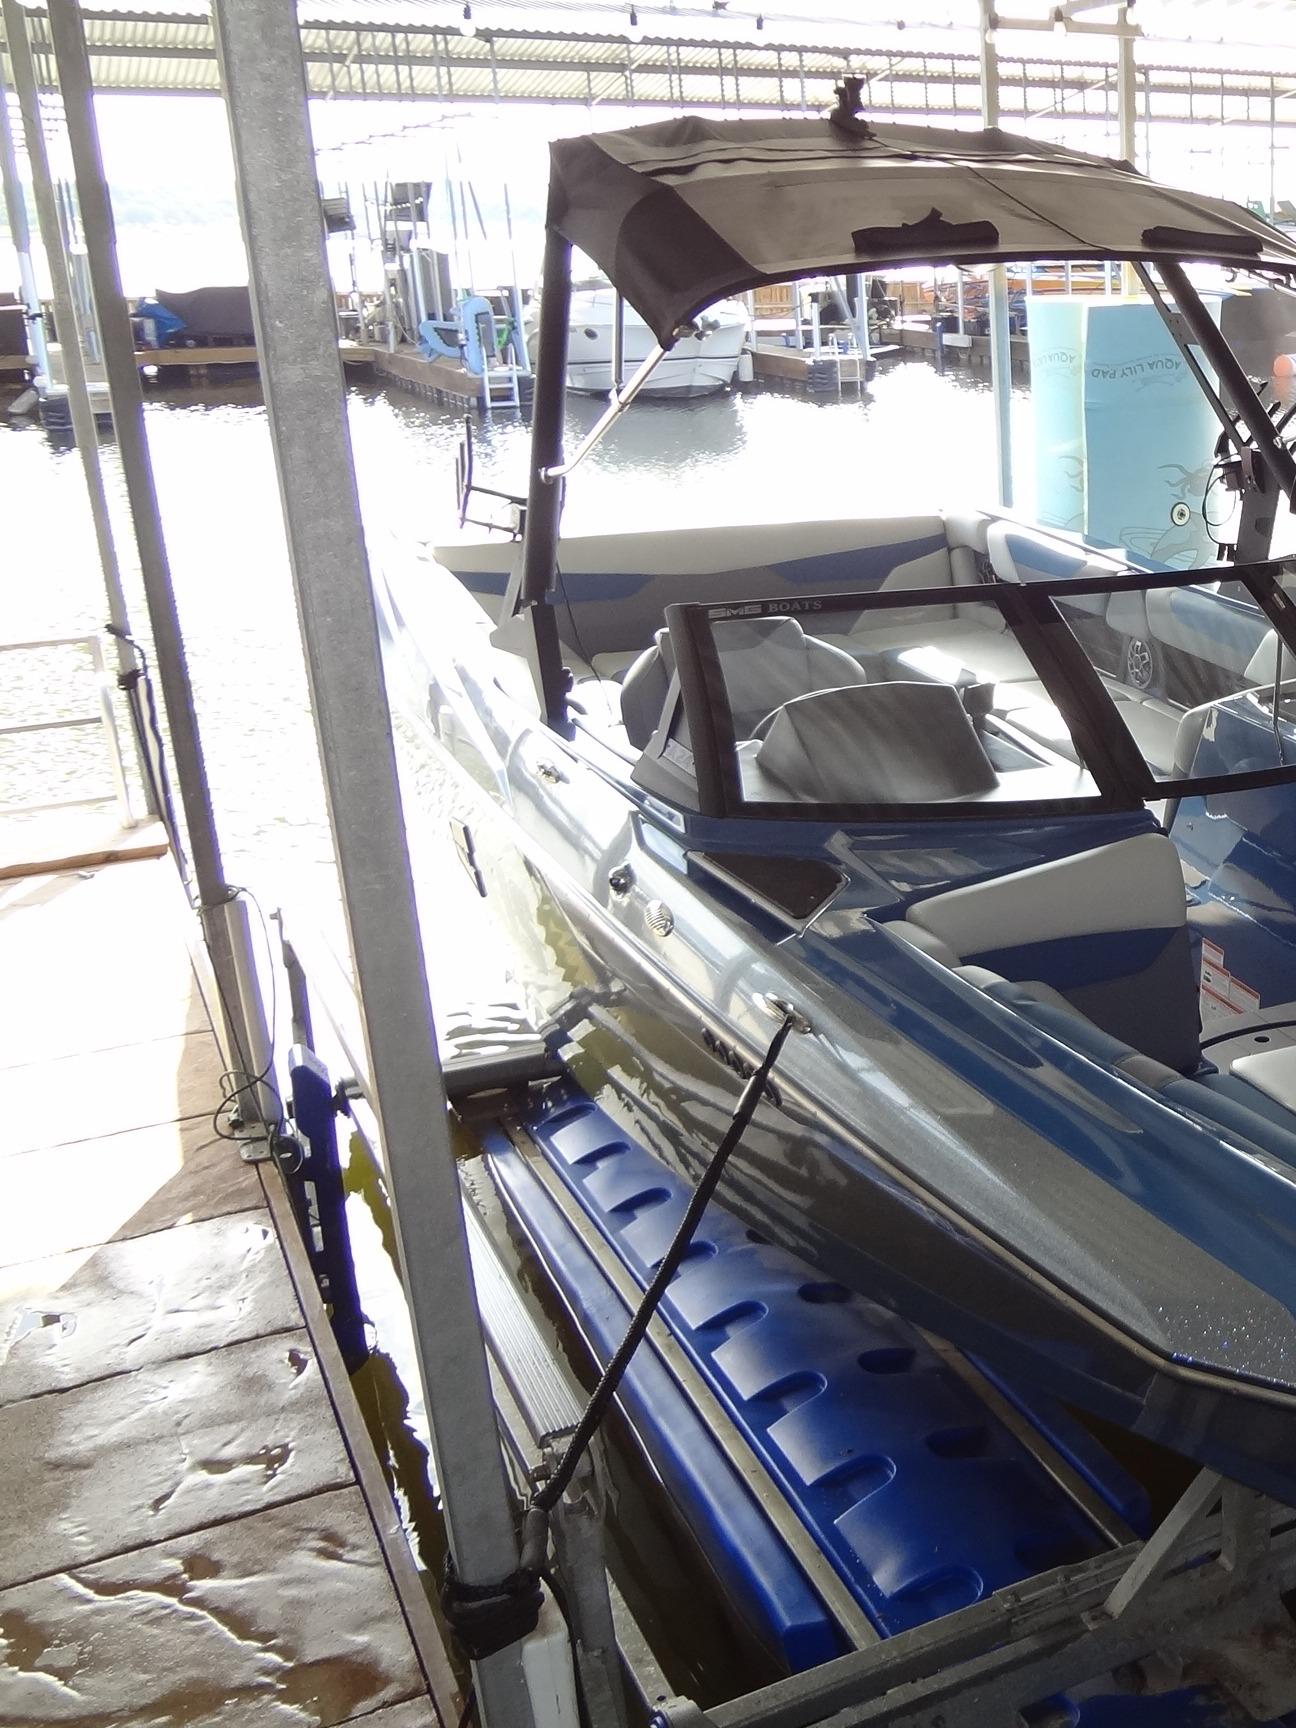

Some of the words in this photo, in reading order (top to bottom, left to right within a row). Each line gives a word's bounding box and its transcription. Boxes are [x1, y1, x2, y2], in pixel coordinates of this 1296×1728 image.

[1147, 357, 1182, 370] AQUA
[1091, 368, 1117, 380] PAD
[1120, 363, 1145, 378] LILY
[768, 600, 822, 613] BOATS
